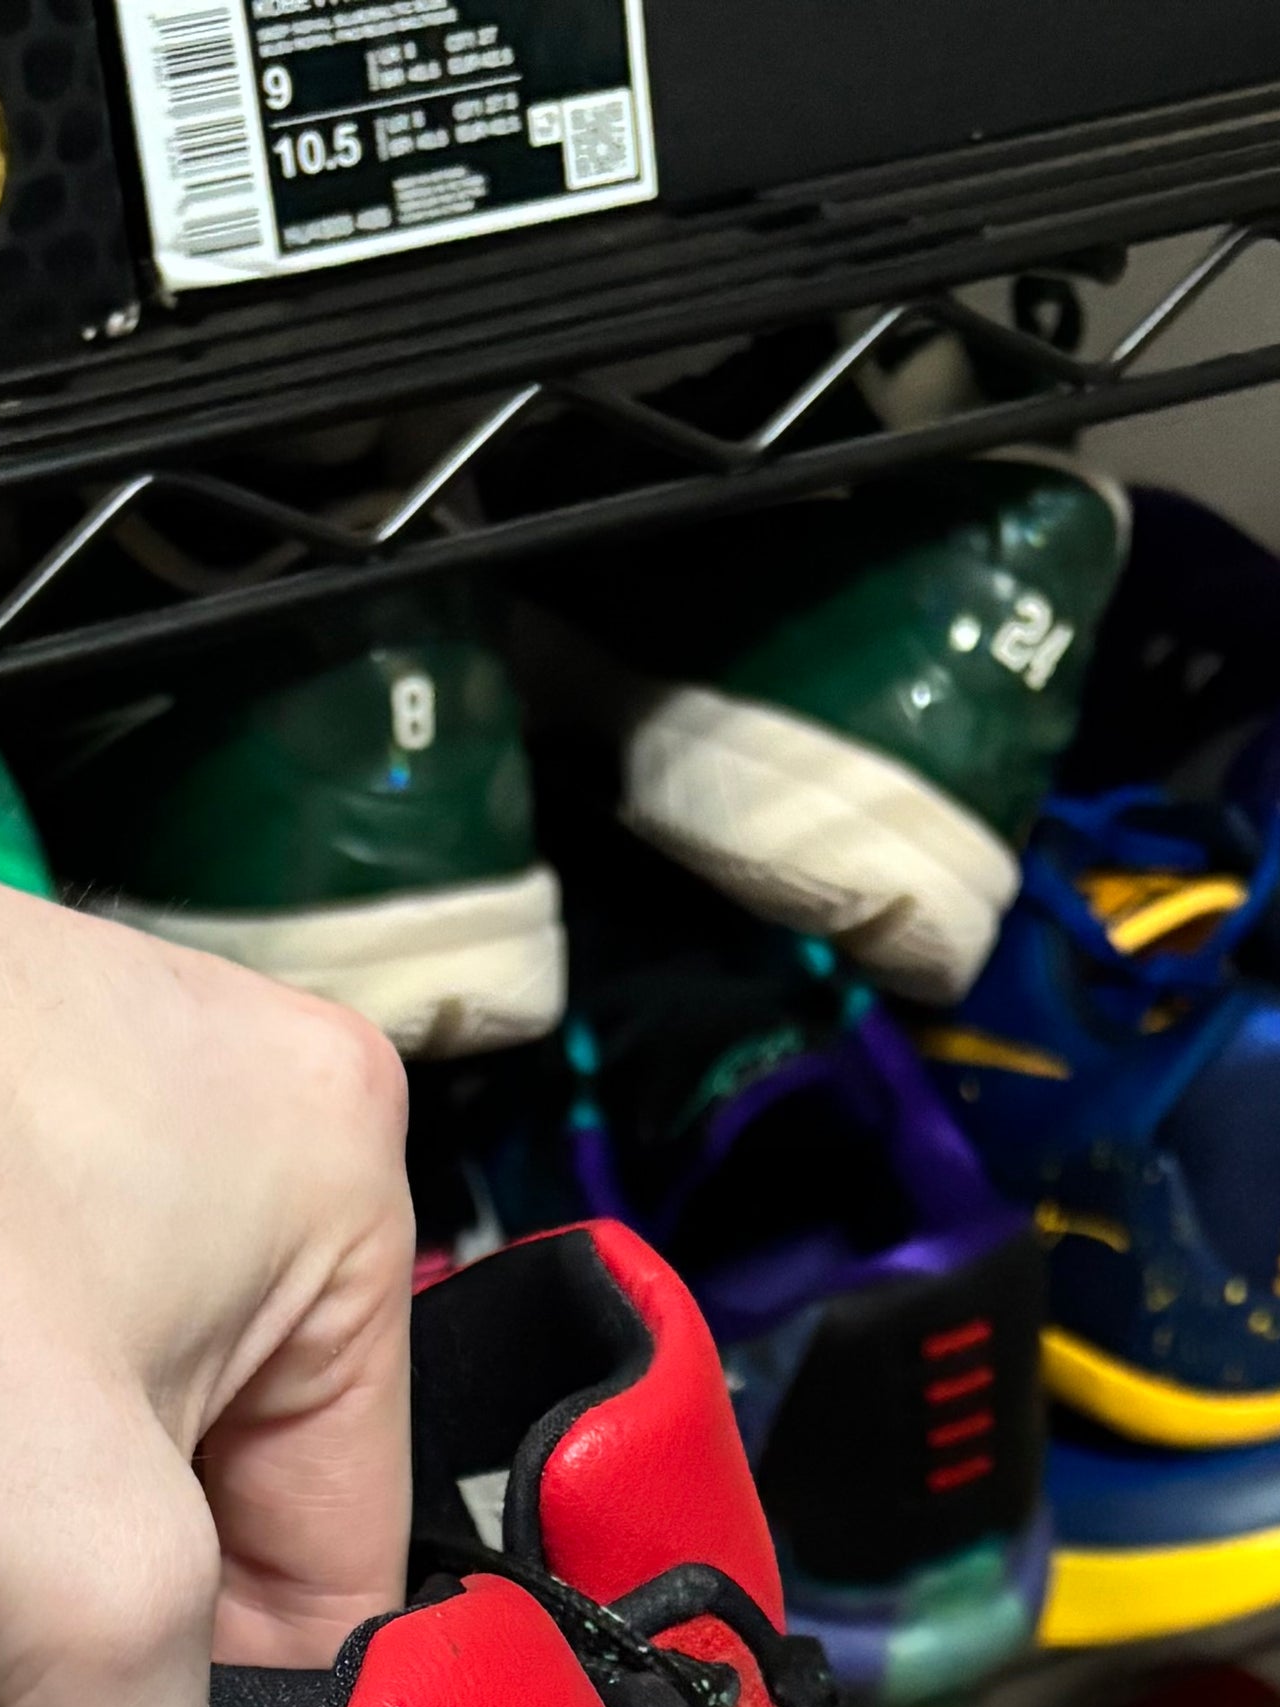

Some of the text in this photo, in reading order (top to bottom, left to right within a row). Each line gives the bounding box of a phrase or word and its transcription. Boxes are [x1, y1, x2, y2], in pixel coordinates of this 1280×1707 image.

[261, 64, 294, 112] 9
[271, 120, 364, 180] 10.5
[390, 675, 437, 750] 8
